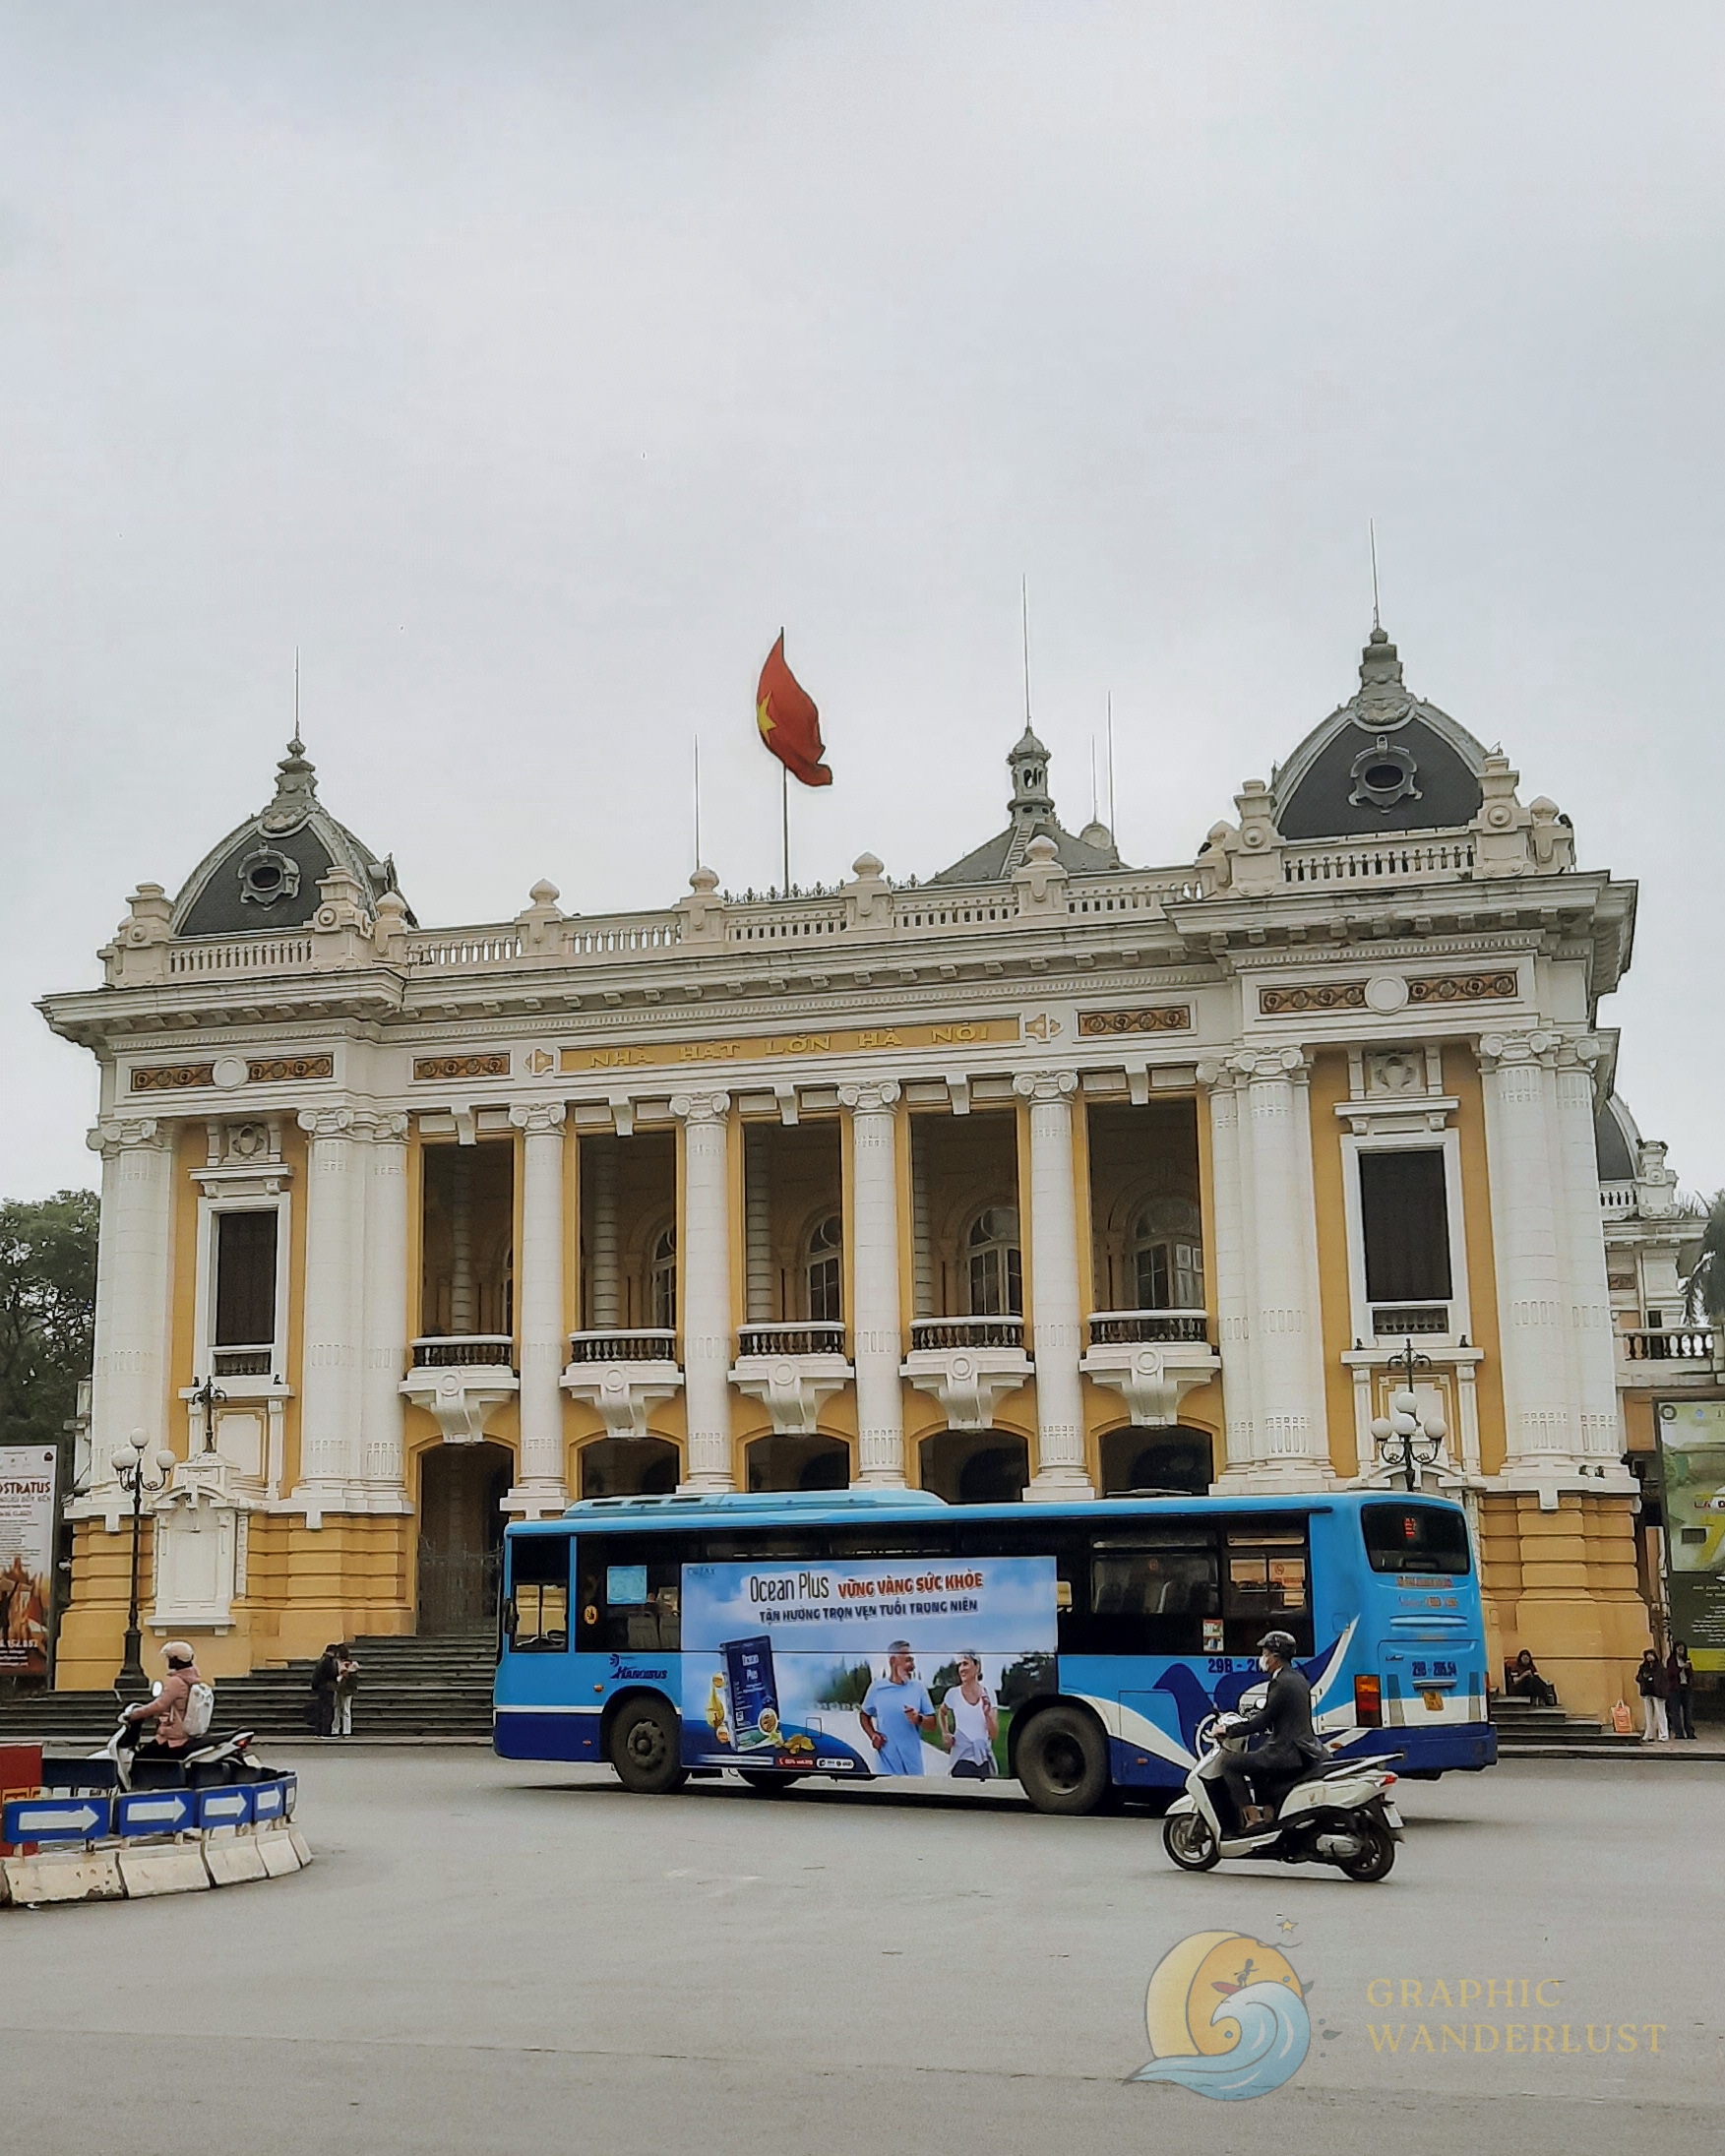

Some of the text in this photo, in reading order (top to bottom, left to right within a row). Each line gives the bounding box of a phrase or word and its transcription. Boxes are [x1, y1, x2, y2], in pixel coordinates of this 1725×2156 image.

[589, 1021, 988, 1068] NHÀ HÁT LỚN HÀ NỘI
[750, 1571, 830, 1602] Ocean Plus
[837, 1568, 983, 1598] VỮNG VÀNG SỨC KHỎE
[760, 1596, 978, 1626] TẬN HƯỞNG TRỌN VẸN TUỔI TRUNG NIÊN
[1207, 1658, 1234, 1674] 29B
